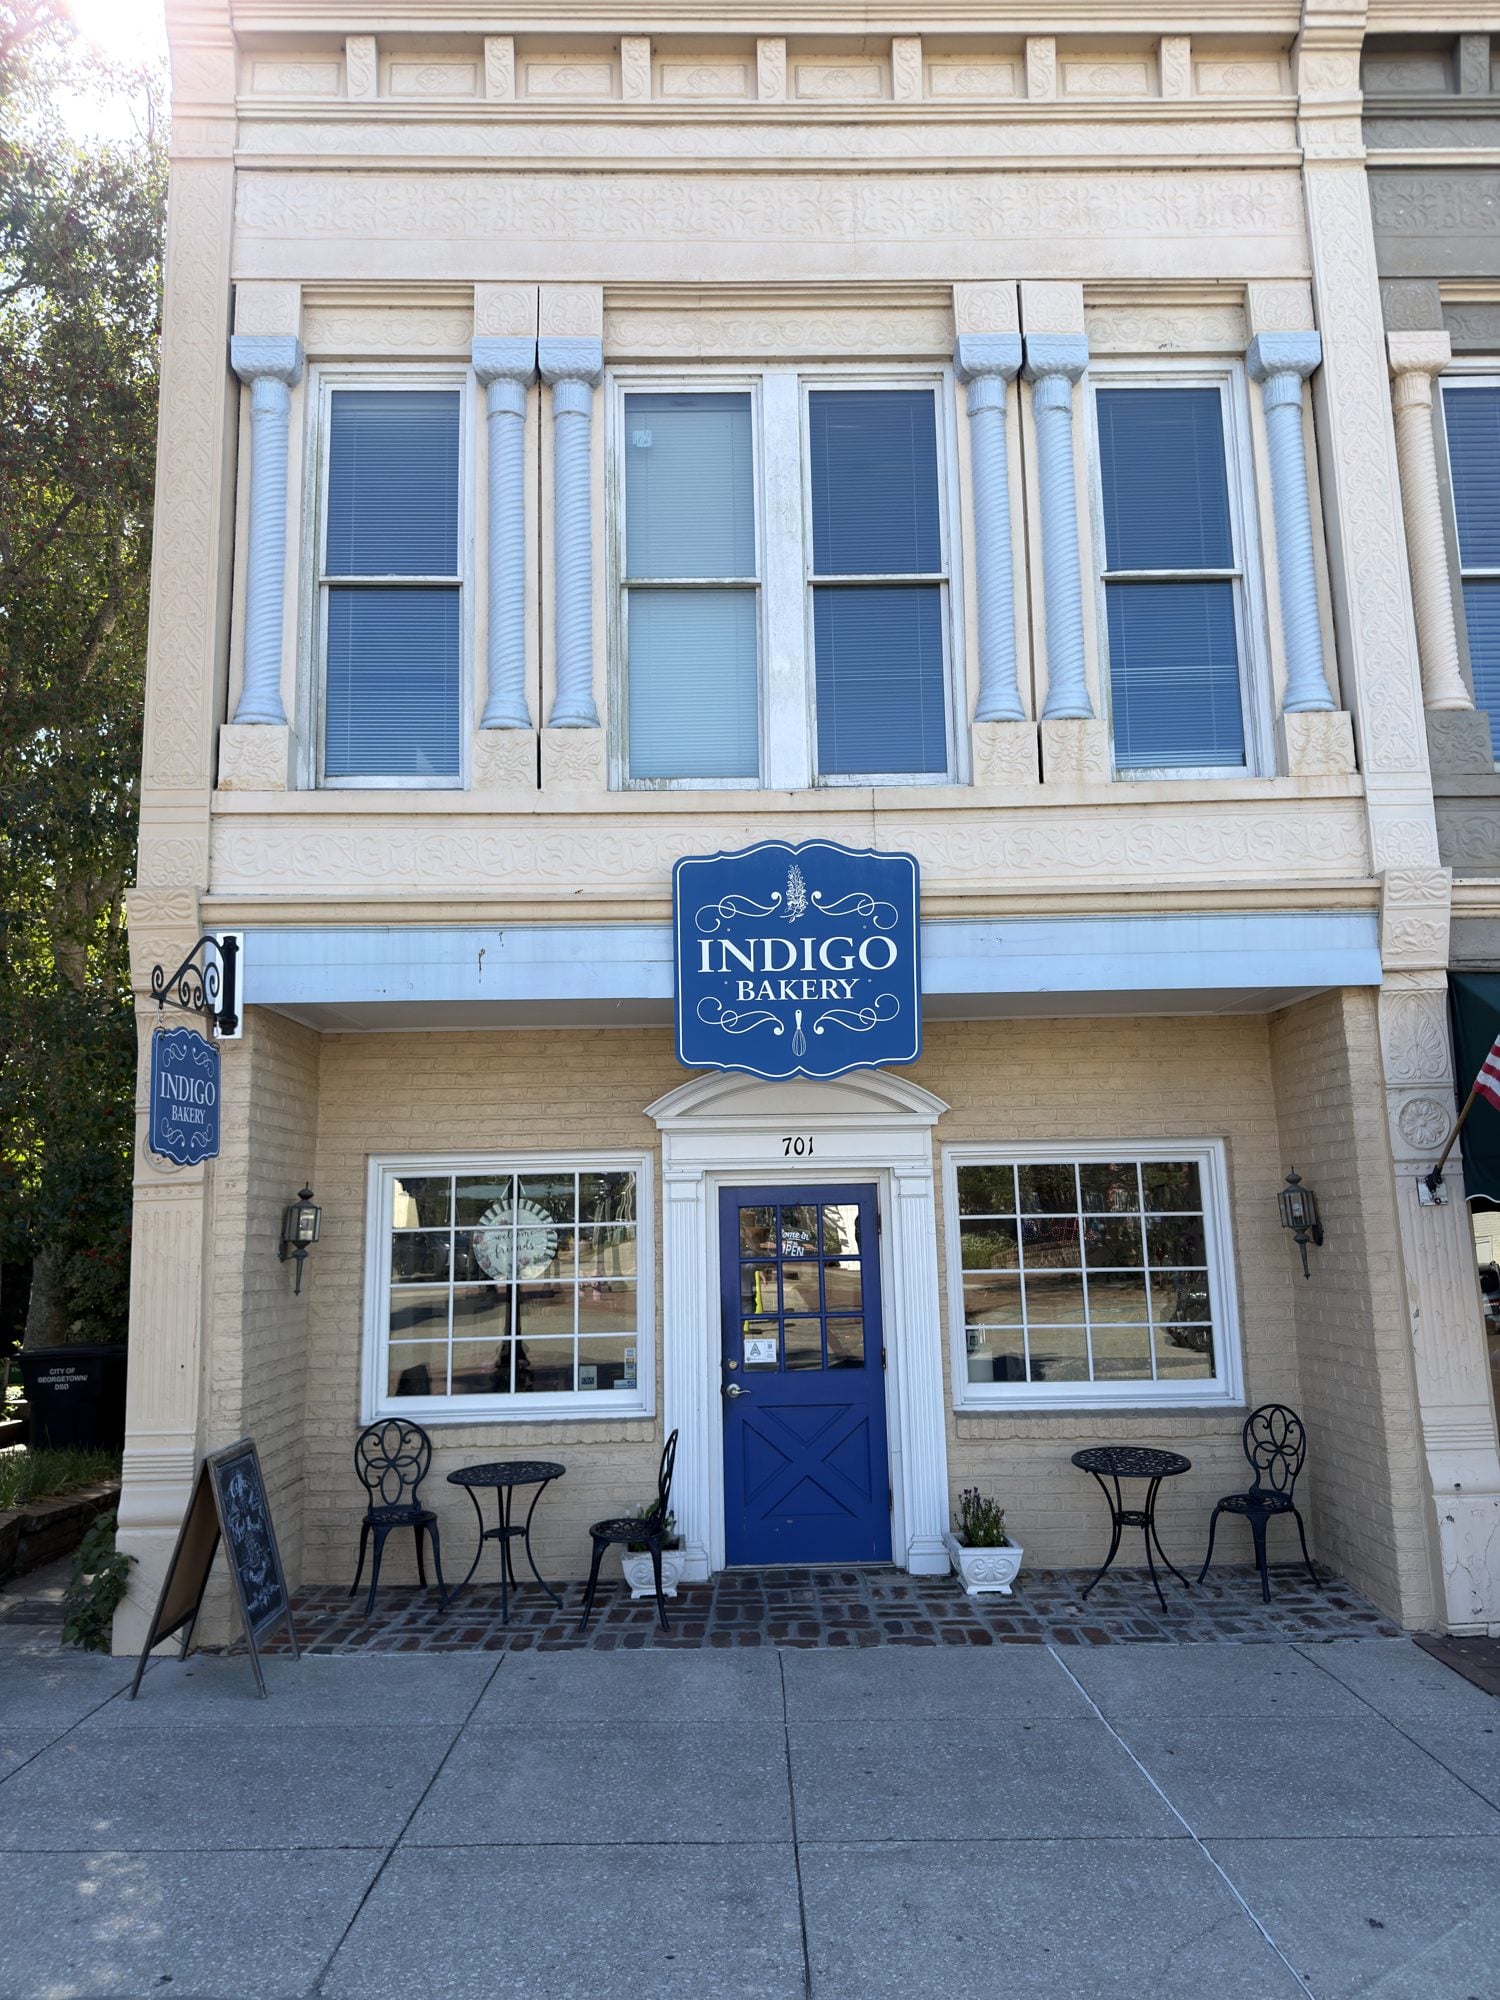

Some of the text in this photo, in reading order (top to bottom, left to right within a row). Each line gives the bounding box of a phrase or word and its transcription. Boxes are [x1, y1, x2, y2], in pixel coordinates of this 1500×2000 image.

[697, 935, 898, 973] INDIGO
[736, 978, 860, 1001] BAKERY
[160, 1072, 216, 1106] INDIGO
[171, 1105, 206, 1124] BAKERY
[782, 1136, 814, 1156] 701
[493, 1230, 537, 1241] welome
[750, 1342, 761, 1356] A
